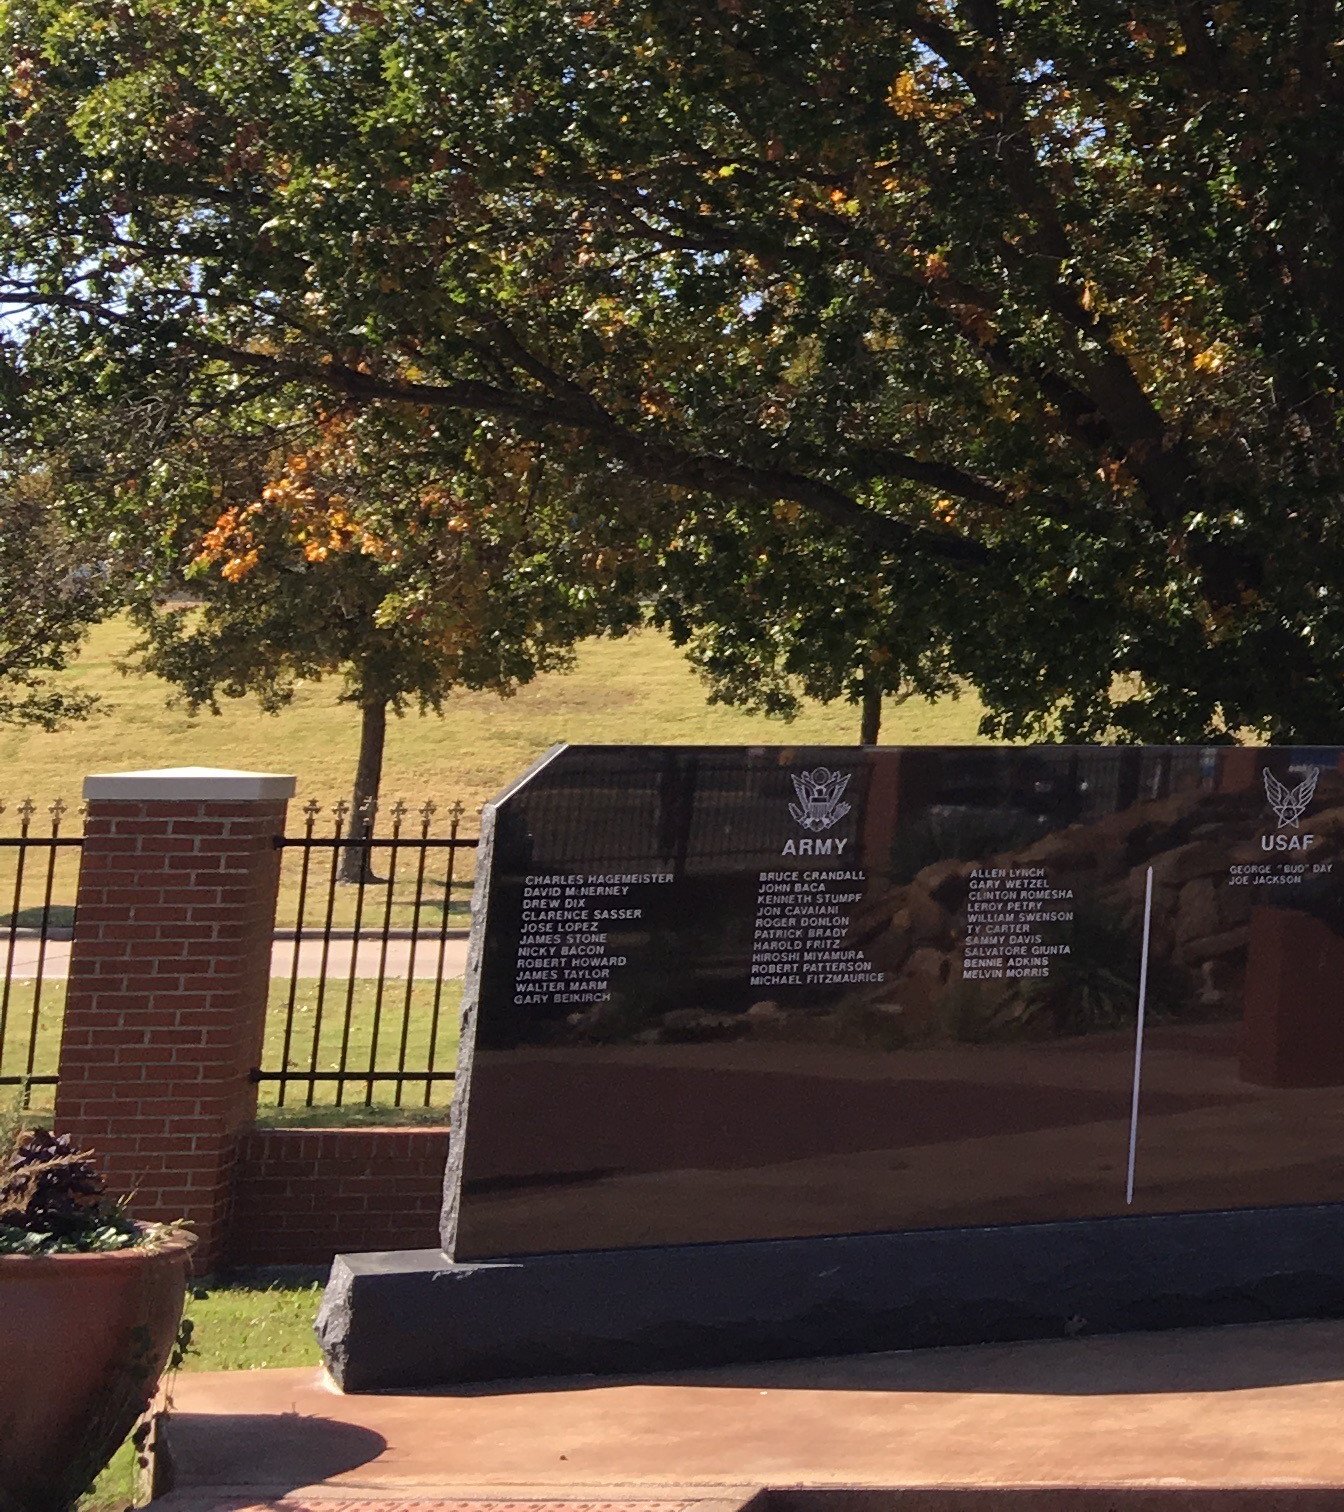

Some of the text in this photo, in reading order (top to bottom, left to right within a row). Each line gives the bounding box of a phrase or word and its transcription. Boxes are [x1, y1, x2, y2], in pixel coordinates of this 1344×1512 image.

[782, 838, 848, 856] ARMY
[1261, 835, 1315, 851] USAF
[1230, 865, 1271, 874] GEORGE
[1313, 864, 1333, 872] DAY
[525, 874, 674, 885] CHARLES HAGEMEISTER
[759, 871, 865, 881] BRUCE CRANDALL
[1229, 876, 1302, 885] JOE JACKSON
[759, 883, 826, 893] JOHN BACA
[970, 879, 1049, 889] GARY WETZEL
[523, 899, 586, 908] DREW DIX
[758, 894, 862, 904] KENNETH STUMPF
[757, 907, 781, 916] JON
[967, 902, 1043, 911] LEROY PETRY
[522, 910, 642, 920] CLARENCE SASSER
[967, 912, 1074, 923] WILLIAM SWENSON
[521, 922, 598, 932] JOSE LOPEZ
[967, 924, 1030, 933] TY CARTER
[519, 934, 607, 945] JAMES STONE
[966, 935, 1042, 945] SAMMY DAVIS
[754, 940, 840, 950] HAROLD FRITZ
[518, 946, 604, 956] NICKY BACON
[965, 945, 1071, 956] SALVATORE GIUNTA
[752, 951, 864, 962] HIROSHI MIYAMURA
[517, 957, 627, 968] ROBERT HOWARD
[752, 962, 872, 973] ROBERT PATTERSON
[516, 969, 610, 980] JAMES TAYLOR
[963, 968, 1049, 979] MELVIN MORRIS
[750, 973, 884, 985] MICHAEL FITZMAURICE
[516, 981, 607, 992] WALTER MARM
[514, 993, 611, 1004] GARY BEIKIRCH
